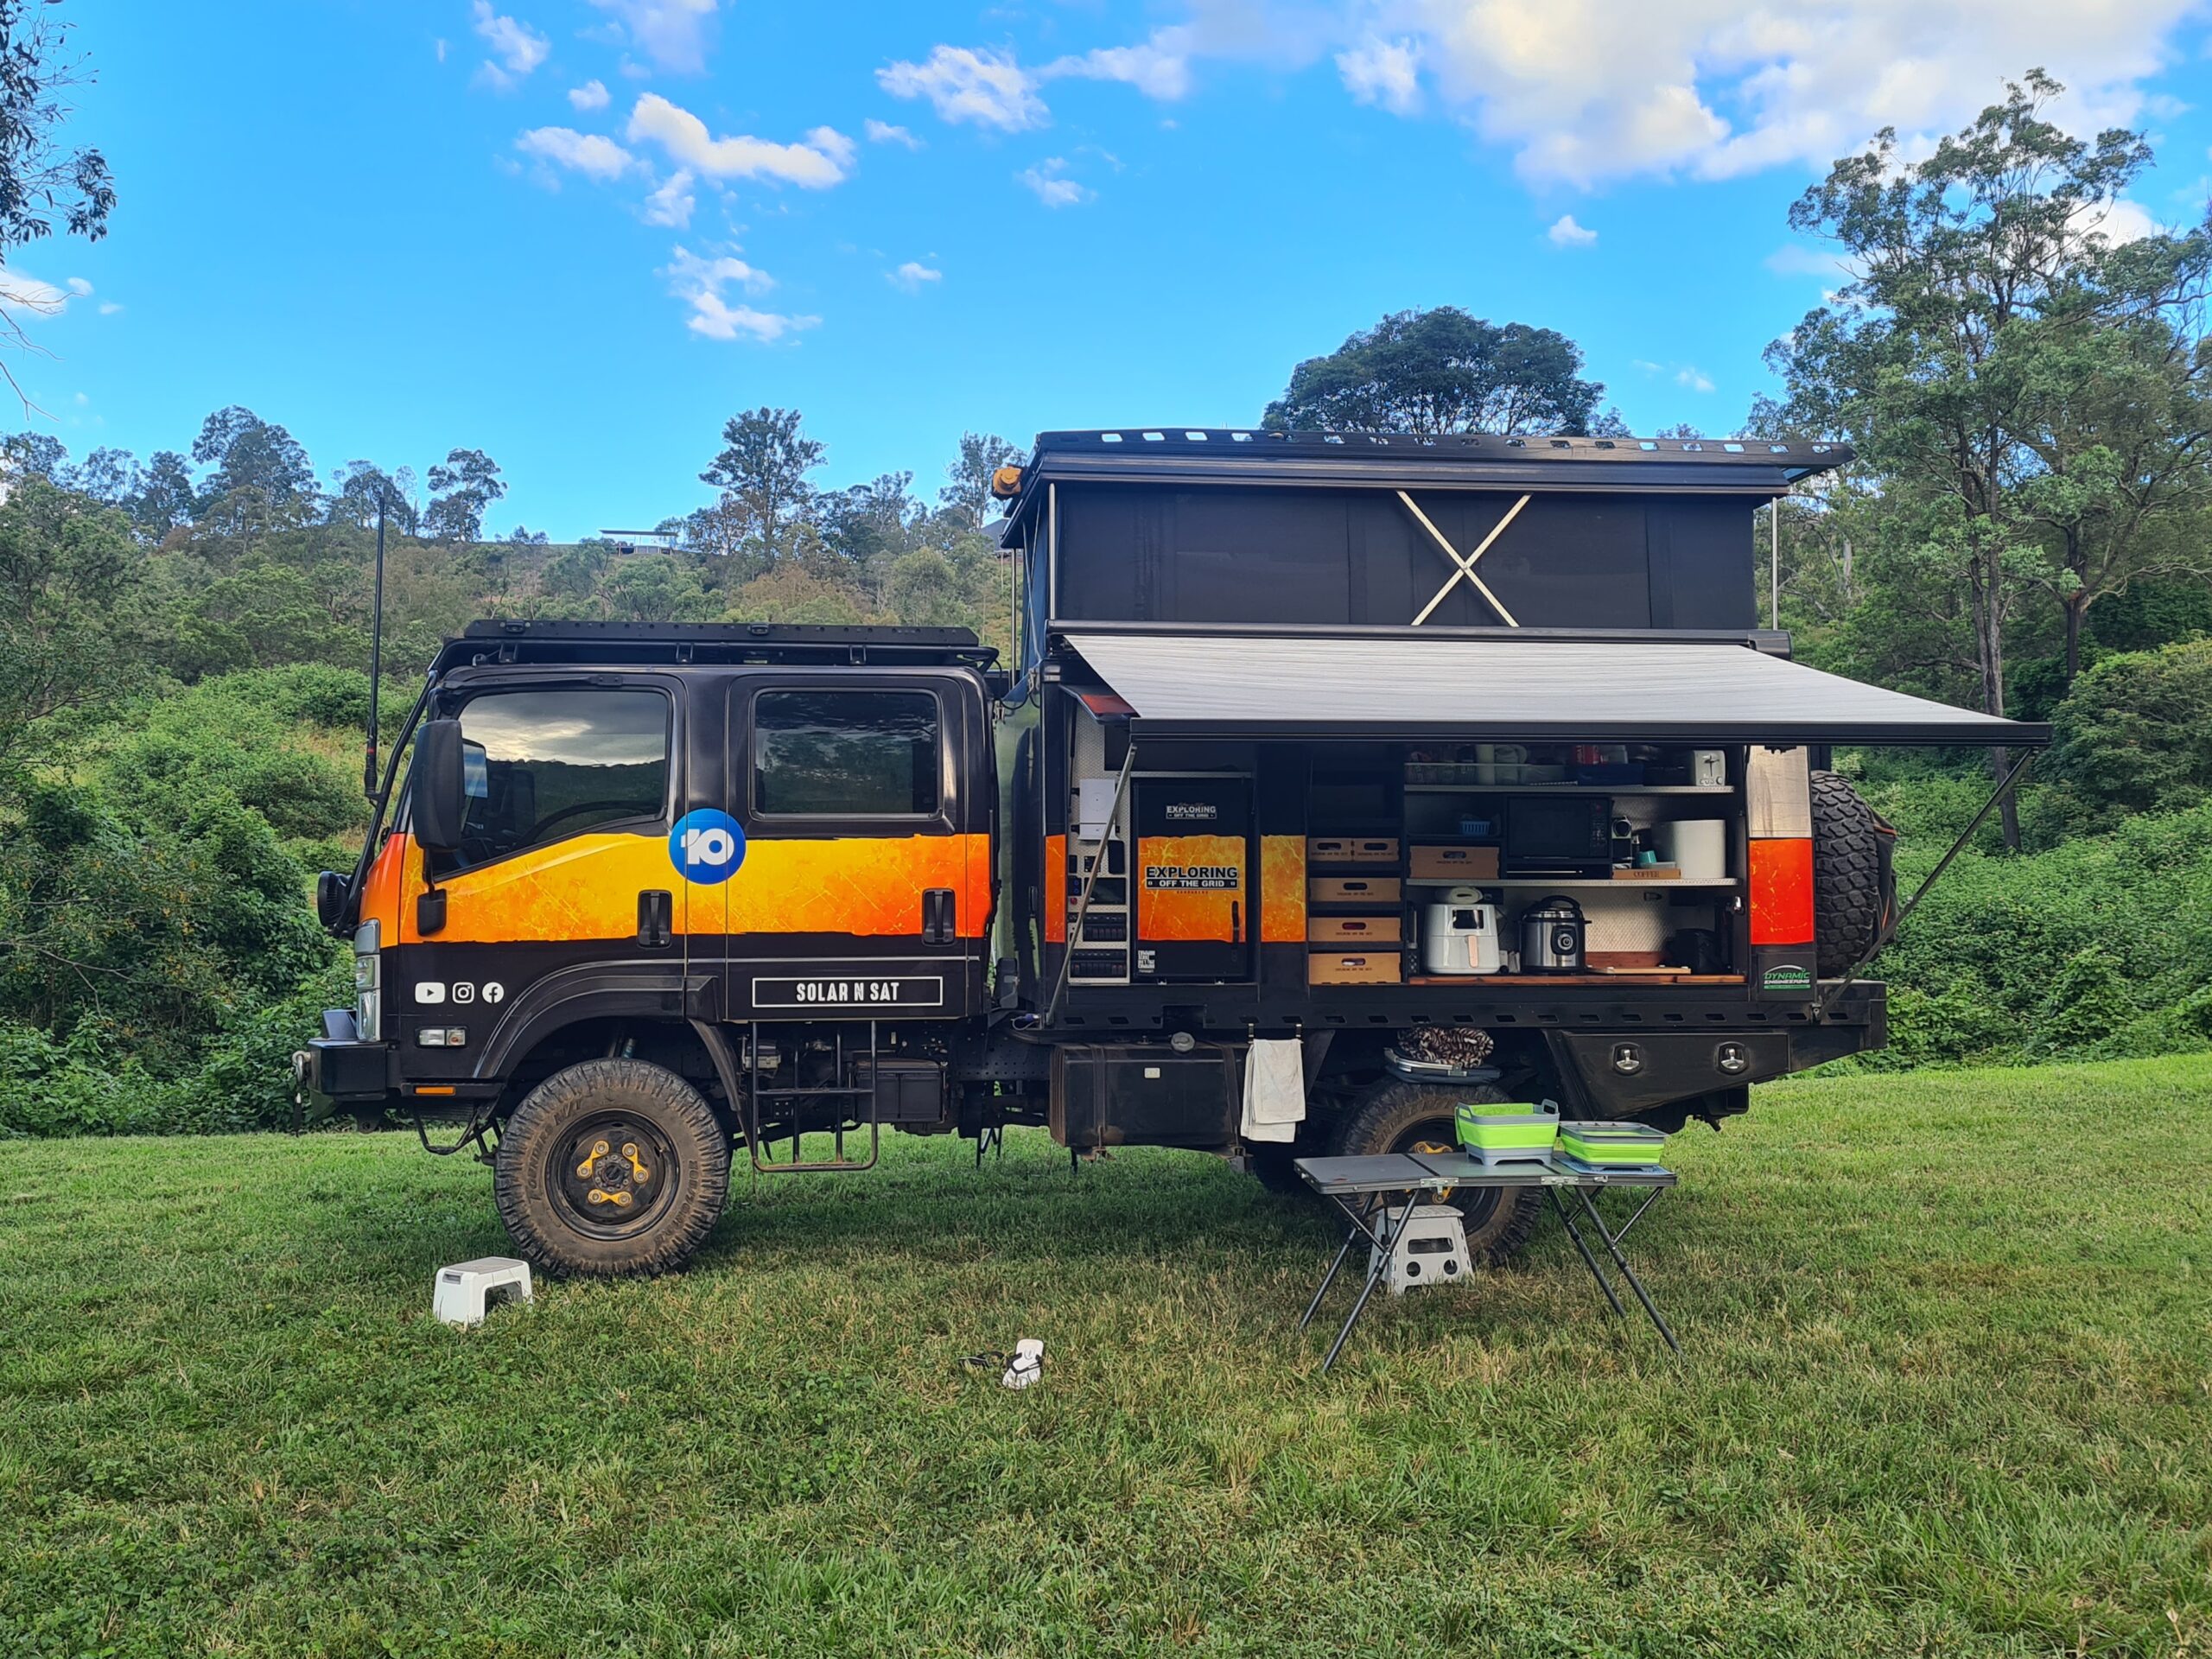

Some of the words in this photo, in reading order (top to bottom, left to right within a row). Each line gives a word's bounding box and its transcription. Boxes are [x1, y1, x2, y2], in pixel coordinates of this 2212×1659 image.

[680, 828, 734, 865] 10
[1146, 867, 1237, 878] EXPLORING
[1764, 971, 1811, 980] DYNAMIC
[796, 982, 849, 1001] SOLAR
[854, 982, 864, 1001] N
[869, 982, 899, 1001] SAT
